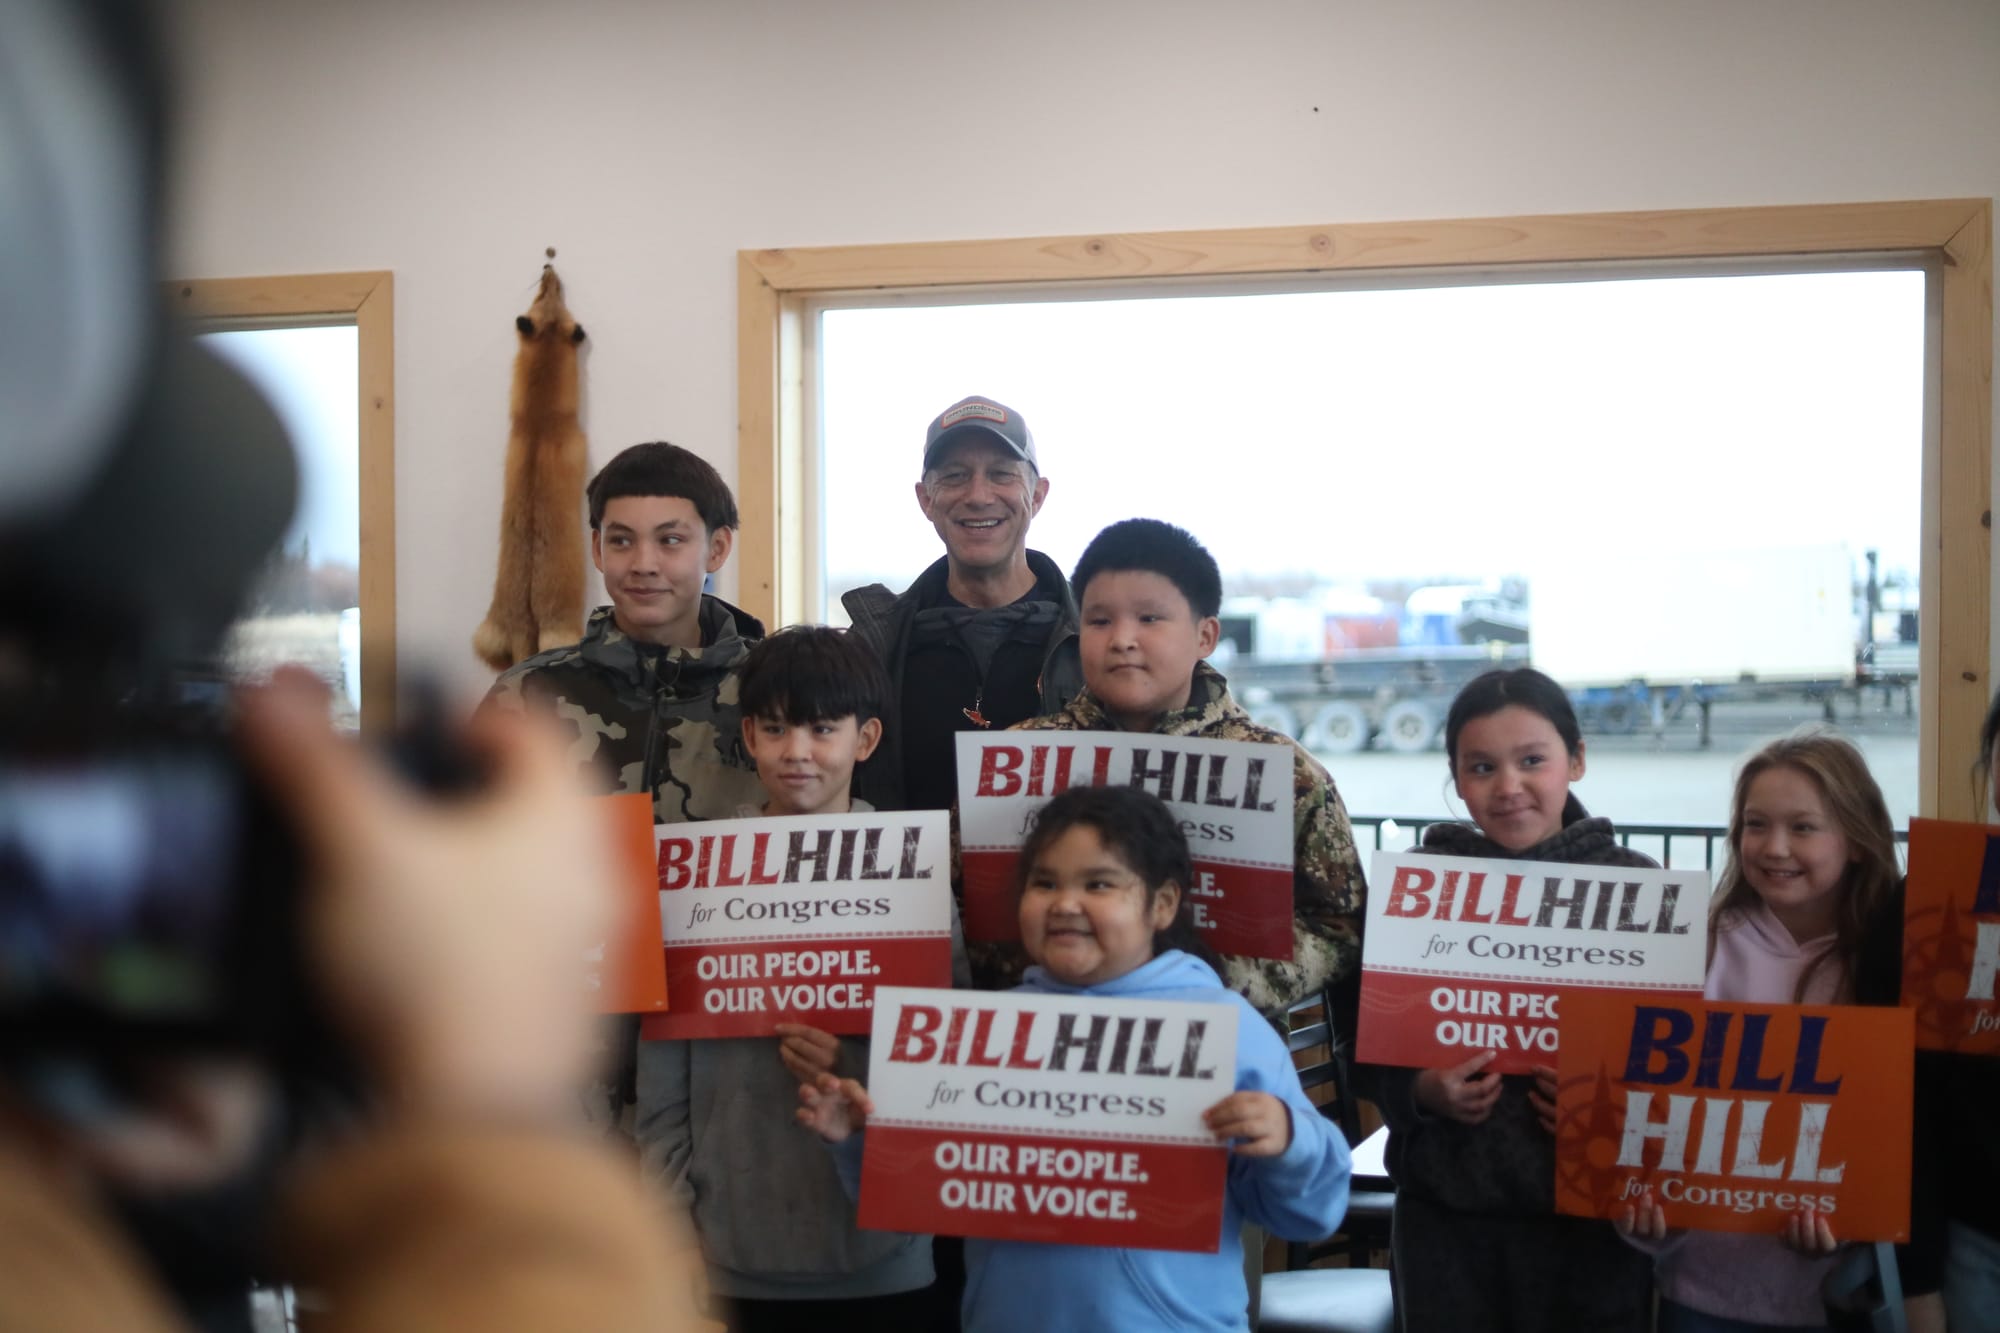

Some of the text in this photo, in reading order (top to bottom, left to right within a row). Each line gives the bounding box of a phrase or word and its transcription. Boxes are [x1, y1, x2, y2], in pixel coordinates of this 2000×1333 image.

[1130, 748, 1278, 812] HILL
[1018, 810, 1039, 835] fo
[657, 826, 934, 891] BILL HILL
[686, 897, 891, 928] for Congress
[1383, 866, 1691, 935] BILL HILL
[697, 950, 881, 980] OUR PEOPLE.
[1421, 934, 1646, 968] for Congress
[704, 984, 873, 1014] OUR VOICE.
[1430, 987, 1503, 1016] OUR
[887, 1004, 1217, 1080] BILL HILL
[1435, 1021, 1509, 1049] OUR
[1623, 1005, 1843, 1096] BILL
[927, 1081, 1166, 1117] for Congress
[1616, 1090, 1846, 1184] HILL
[934, 1142, 1149, 1183] OUR PEOPLE.
[940, 1180, 1137, 1220] OUR VOICE.
[1619, 1176, 1836, 1213] for Congress
